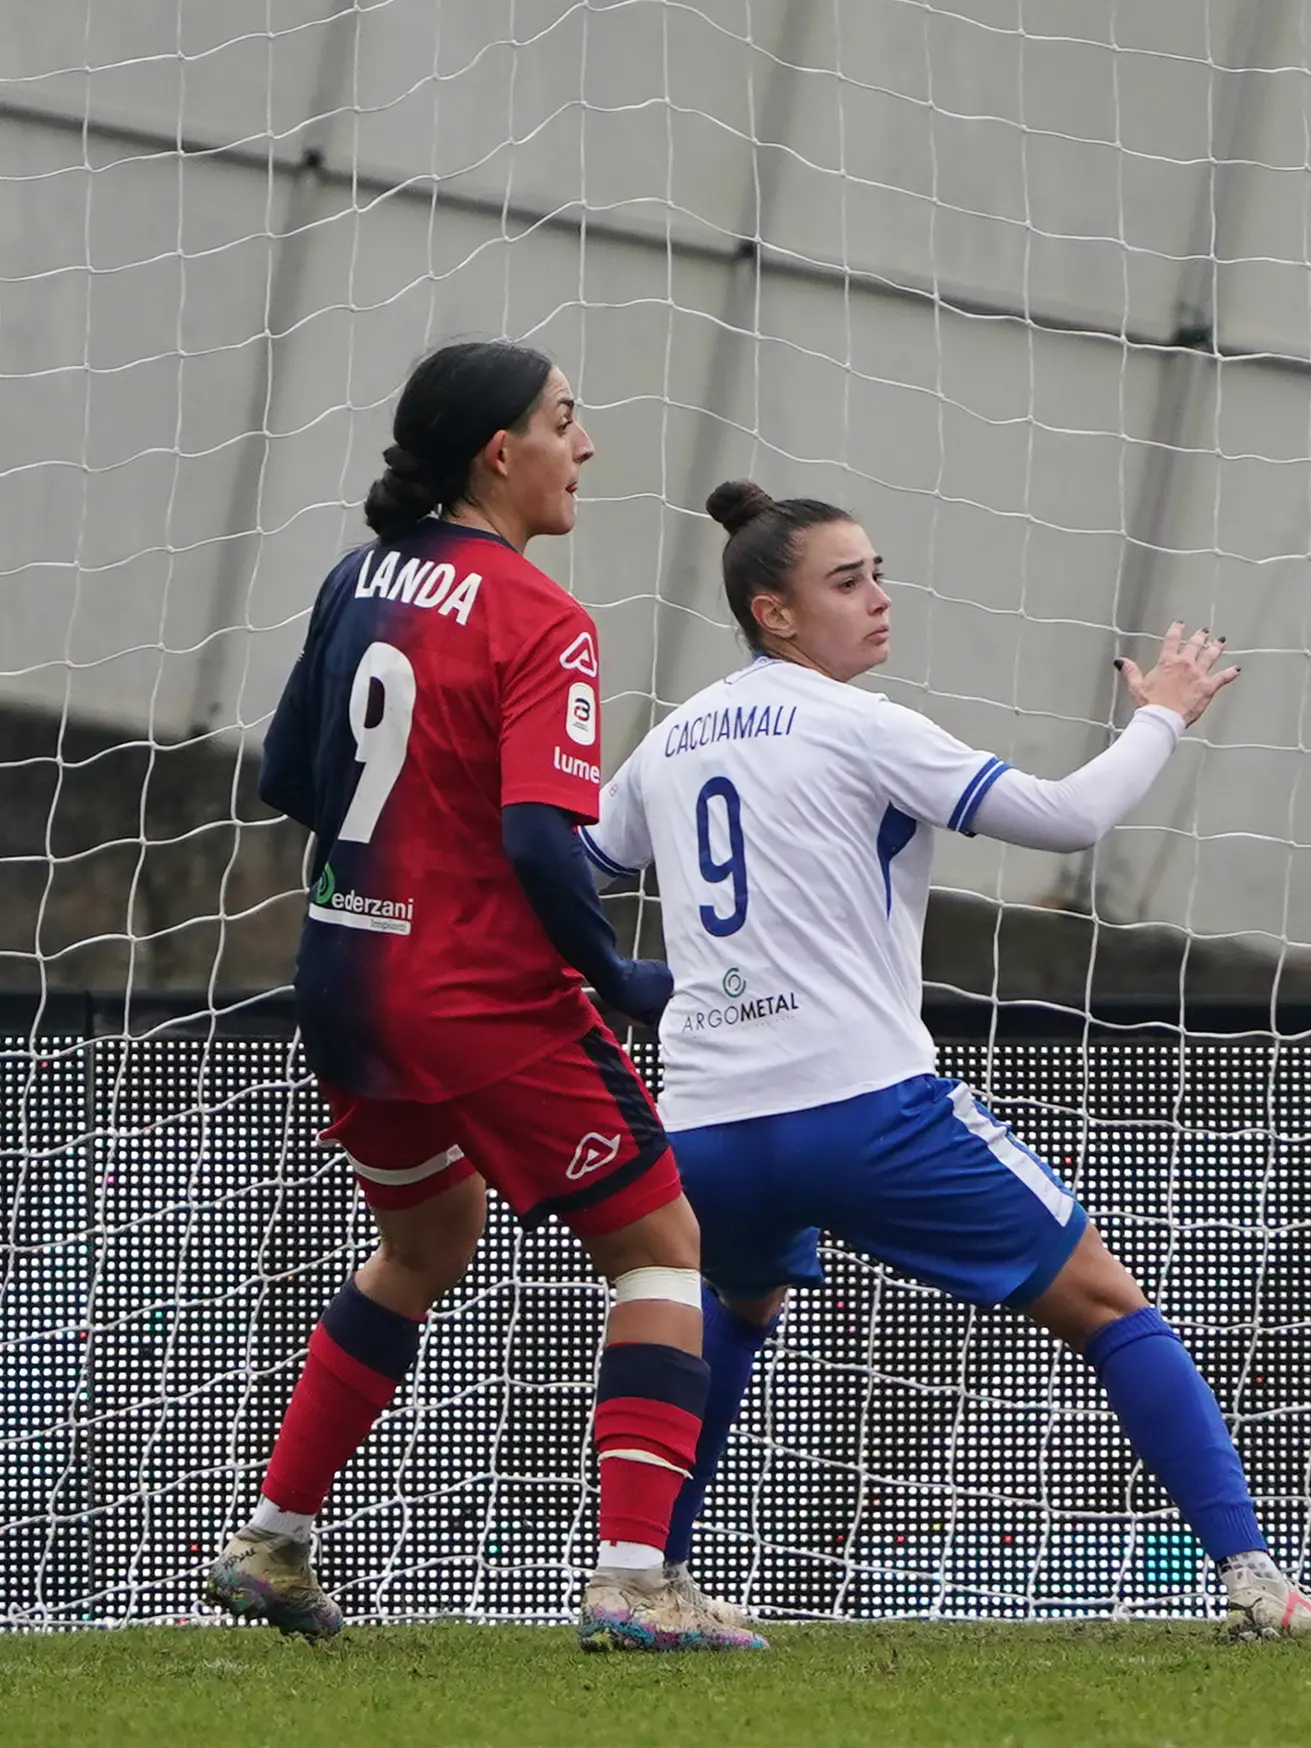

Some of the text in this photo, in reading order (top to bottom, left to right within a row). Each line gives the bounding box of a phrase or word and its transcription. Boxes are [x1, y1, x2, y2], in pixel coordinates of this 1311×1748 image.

[354, 550, 482, 625] LANDA
[338, 641, 416, 843] 9
[664, 705, 798, 757] CACCIAMALI
[554, 746, 600, 783] lume
[696, 775, 748, 937] 9
[682, 992, 799, 1033] ARGOMETAL
